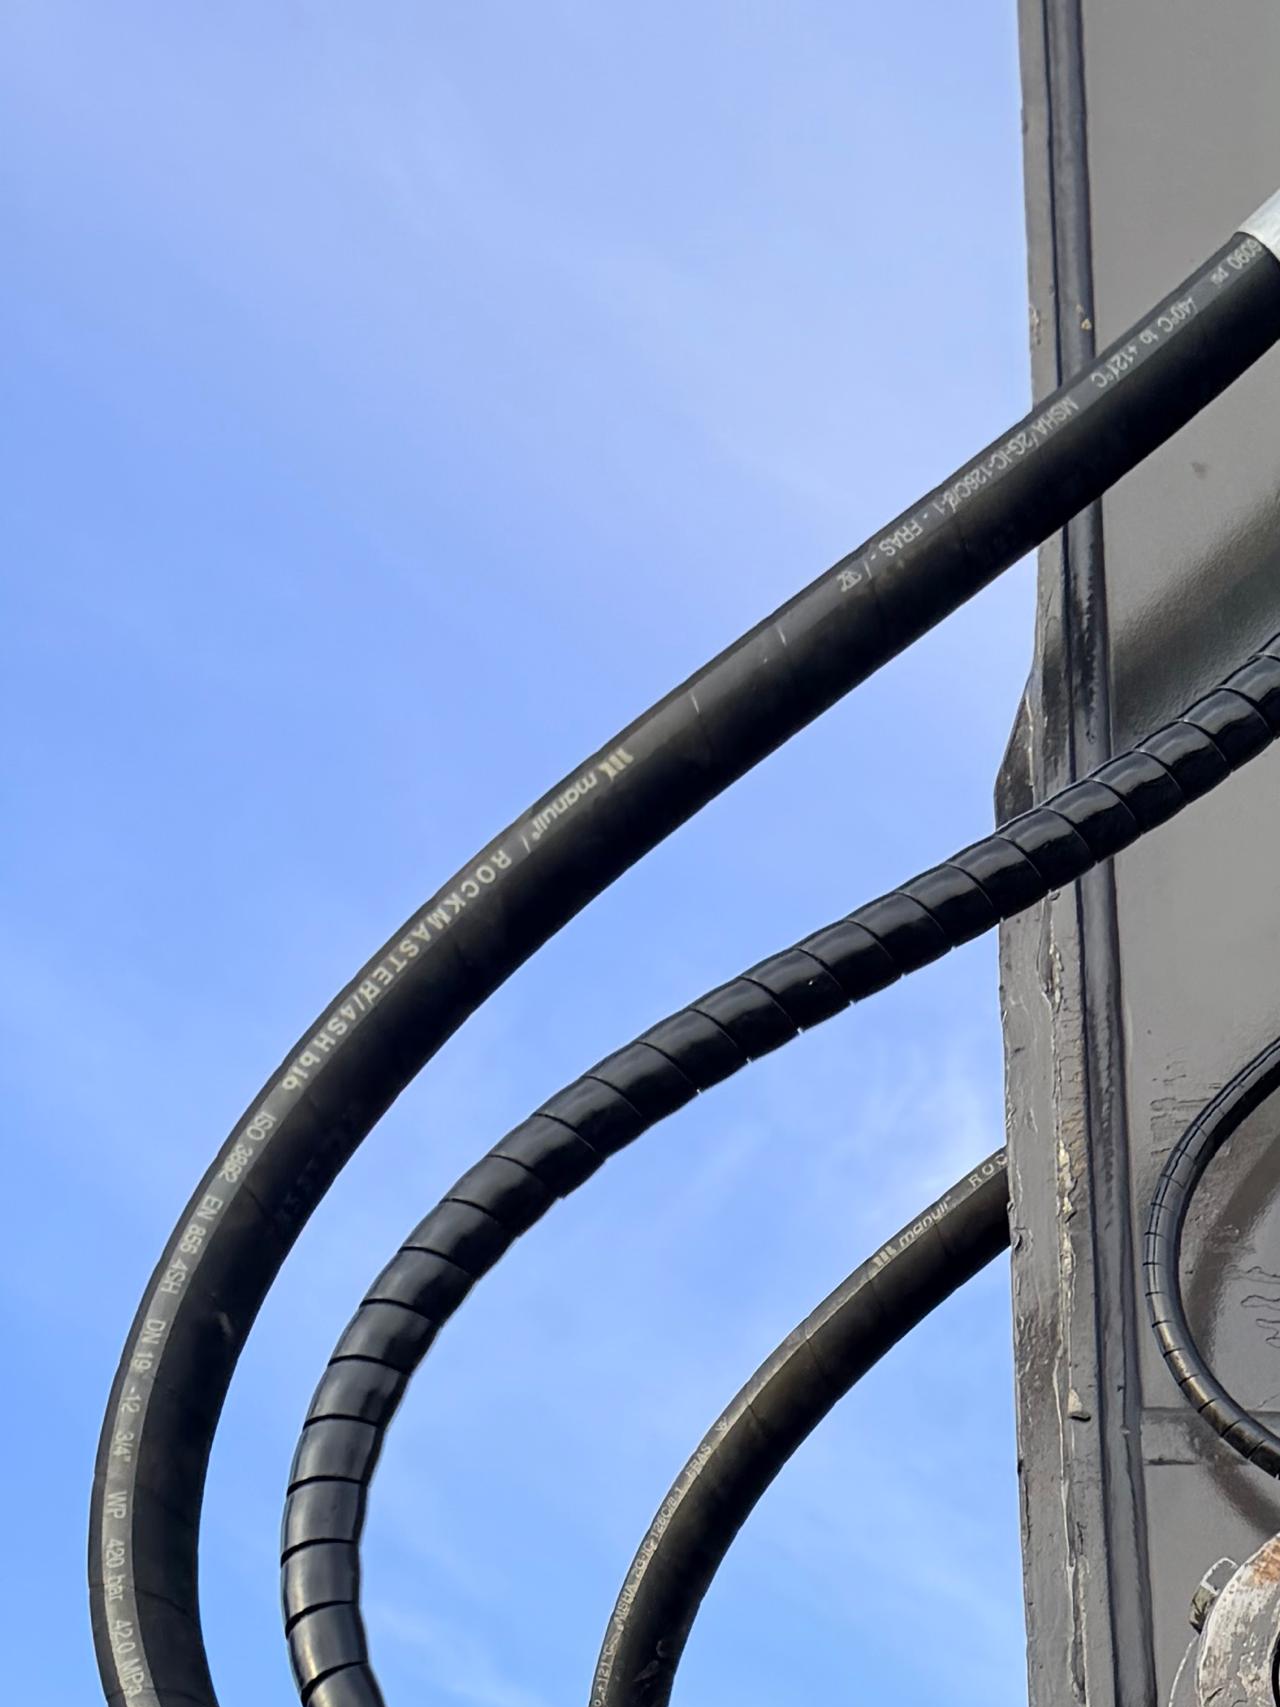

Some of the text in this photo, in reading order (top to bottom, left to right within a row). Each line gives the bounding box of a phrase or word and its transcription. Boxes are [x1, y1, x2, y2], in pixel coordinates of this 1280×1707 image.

[1138, 329, 1161, 345] to
[1031, 396, 1080, 436] MSHA
[246, 1111, 278, 1142] ISO
[218, 1142, 254, 1183] 3862
[196, 1194, 224, 1221] EN
[180, 1225, 207, 1254] 856
[161, 1257, 189, 1296] 4SH
[139, 1318, 167, 1346] DN
[107, 1491, 128, 1520] WP
[105, 1539, 126, 1569] 420
[105, 1572, 126, 1602] bar
[119, 1660, 145, 1698] MPa
